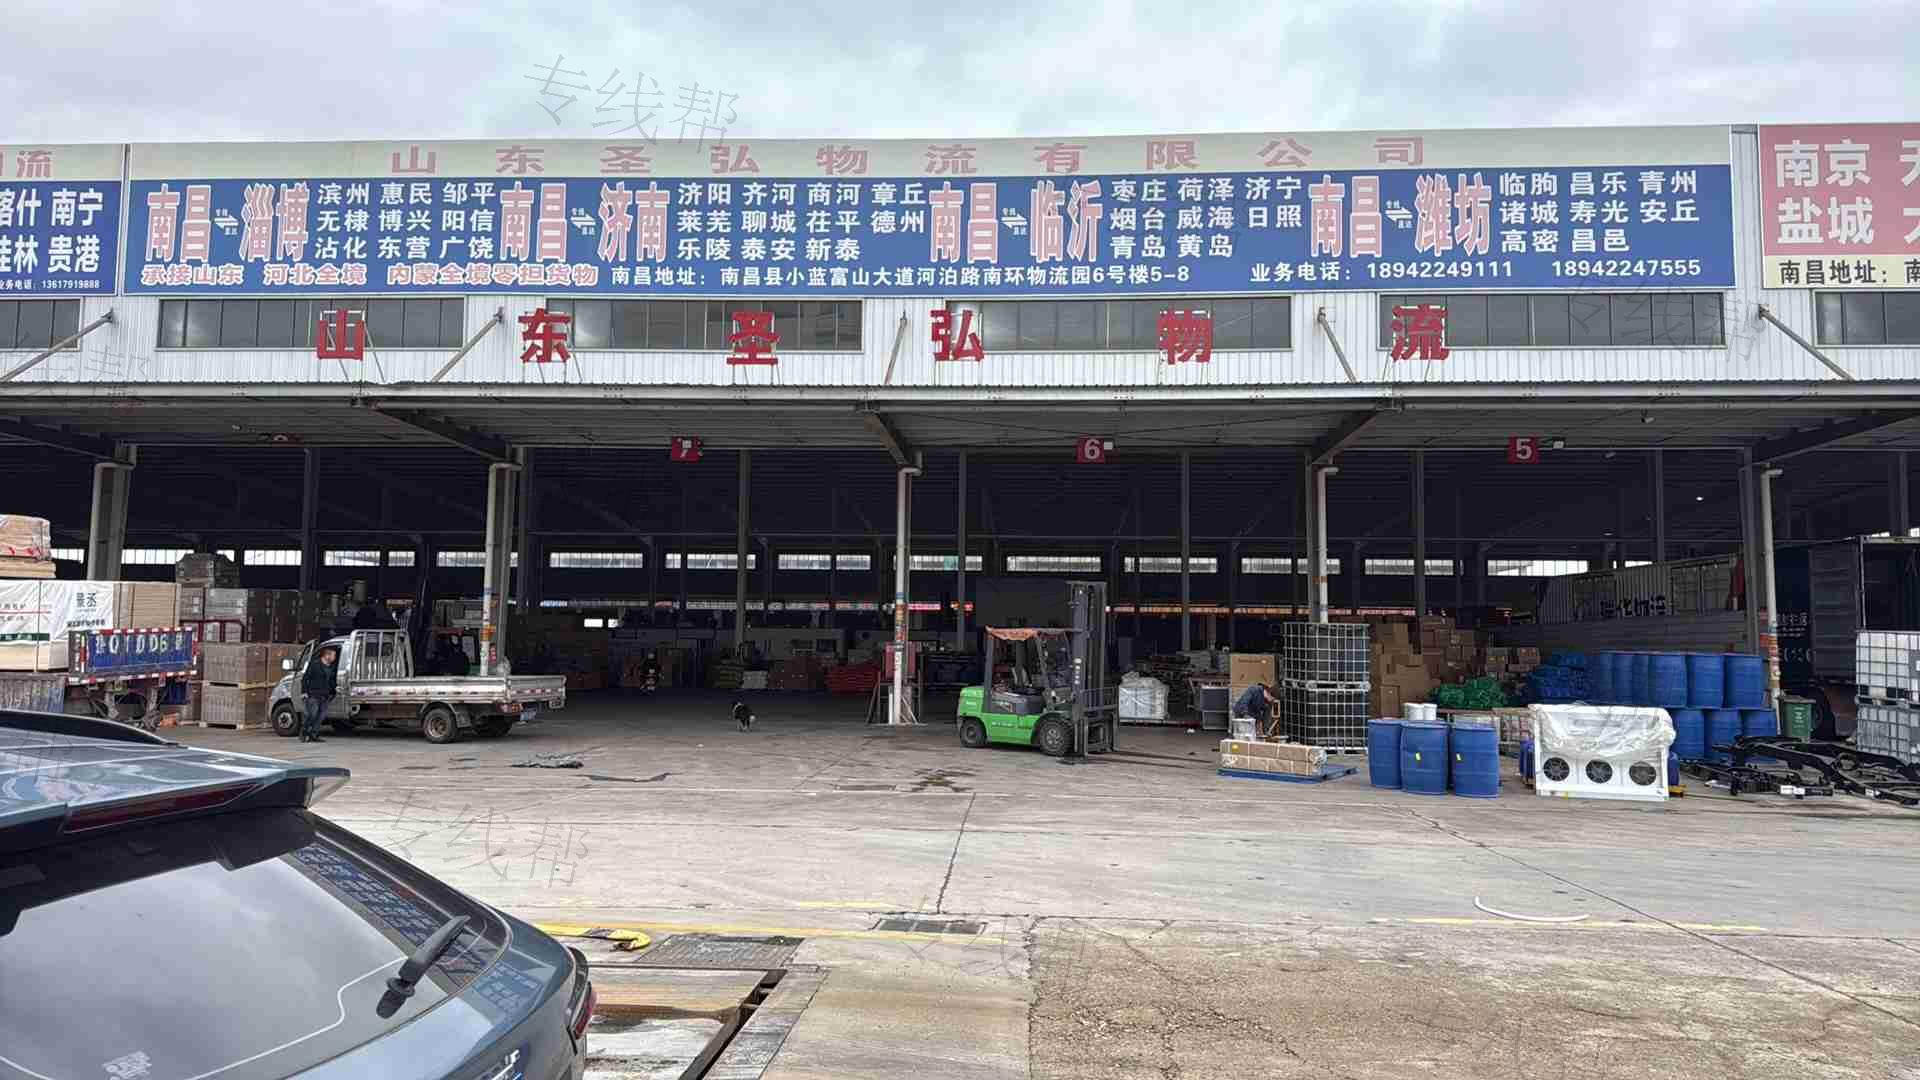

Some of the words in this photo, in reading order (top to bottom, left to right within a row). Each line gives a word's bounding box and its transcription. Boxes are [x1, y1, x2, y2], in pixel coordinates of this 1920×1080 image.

[392, 137, 1424, 176] 山东圣弘物流有限公司
[1774, 139, 1871, 188] 南京
[317, 182, 370, 205] 滨州
[380, 182, 432, 205] 惠民
[442, 182, 497, 205] 邹平
[677, 182, 731, 205] 济阳
[742, 182, 797, 205] 齐河
[807, 183, 861, 205] 商河
[871, 182, 926, 205] 章丘
[1111, 178, 1167, 202] 枣庄
[1246, 176, 1302, 201] 济宁
[1570, 171, 1627, 196] 昌乐
[1638, 169, 1698, 194] 青州
[51, 188, 103, 226] 南宁
[316, 208, 369, 232] 无棣
[378, 209, 432, 232] 博兴
[441, 208, 495, 232] 阳信
[1110, 206, 1166, 231] 烟台
[1176, 205, 1234, 230] 威海
[1249, 204, 1302, 228] 日照
[1308, 174, 1382, 257] 南昌
[1415, 172, 1492, 256] 潍坊
[1500, 200, 1559, 225] 诸城
[1569, 199, 1628, 224] 寿光
[1640, 198, 1699, 223] 安丘
[1777, 196, 1875, 244] 盐城
[146, 183, 211, 262] 南昌
[239, 181, 311, 262] 淄博
[500, 181, 567, 262] 南昌
[598, 181, 670, 262] 济南
[677, 210, 732, 233] 莱芜
[741, 210, 797, 233] 聊城
[870, 210, 925, 233] 德州
[929, 181, 998, 263] 南昌
[1030, 180, 1103, 263] 临沂
[315, 236, 367, 260] 沾化
[377, 236, 431, 260] 东营
[439, 235, 494, 260] 广饶
[677, 238, 732, 261] 乐陵
[741, 238, 796, 261] 泰安
[805, 238, 861, 261] 新泰
[1110, 234, 1166, 259] 青岛
[1177, 233, 1233, 258] 黄岛
[1500, 228, 1559, 253] 高密
[1571, 227, 1630, 253] 昌邑
[48, 234, 100, 273] 贵港
[140, 263, 244, 286] 承接山东
[263, 263, 367, 286] 河北全境
[387, 262, 599, 287] 内蒙全境零担货物
[1367, 260, 1513, 279] 18942249111
[1552, 258, 1702, 277] 18942247555
[316, 304, 1449, 366] 山东圣弘物流
[1085, 438, 1100, 459] 6
[1515, 438, 1533, 460] 5
